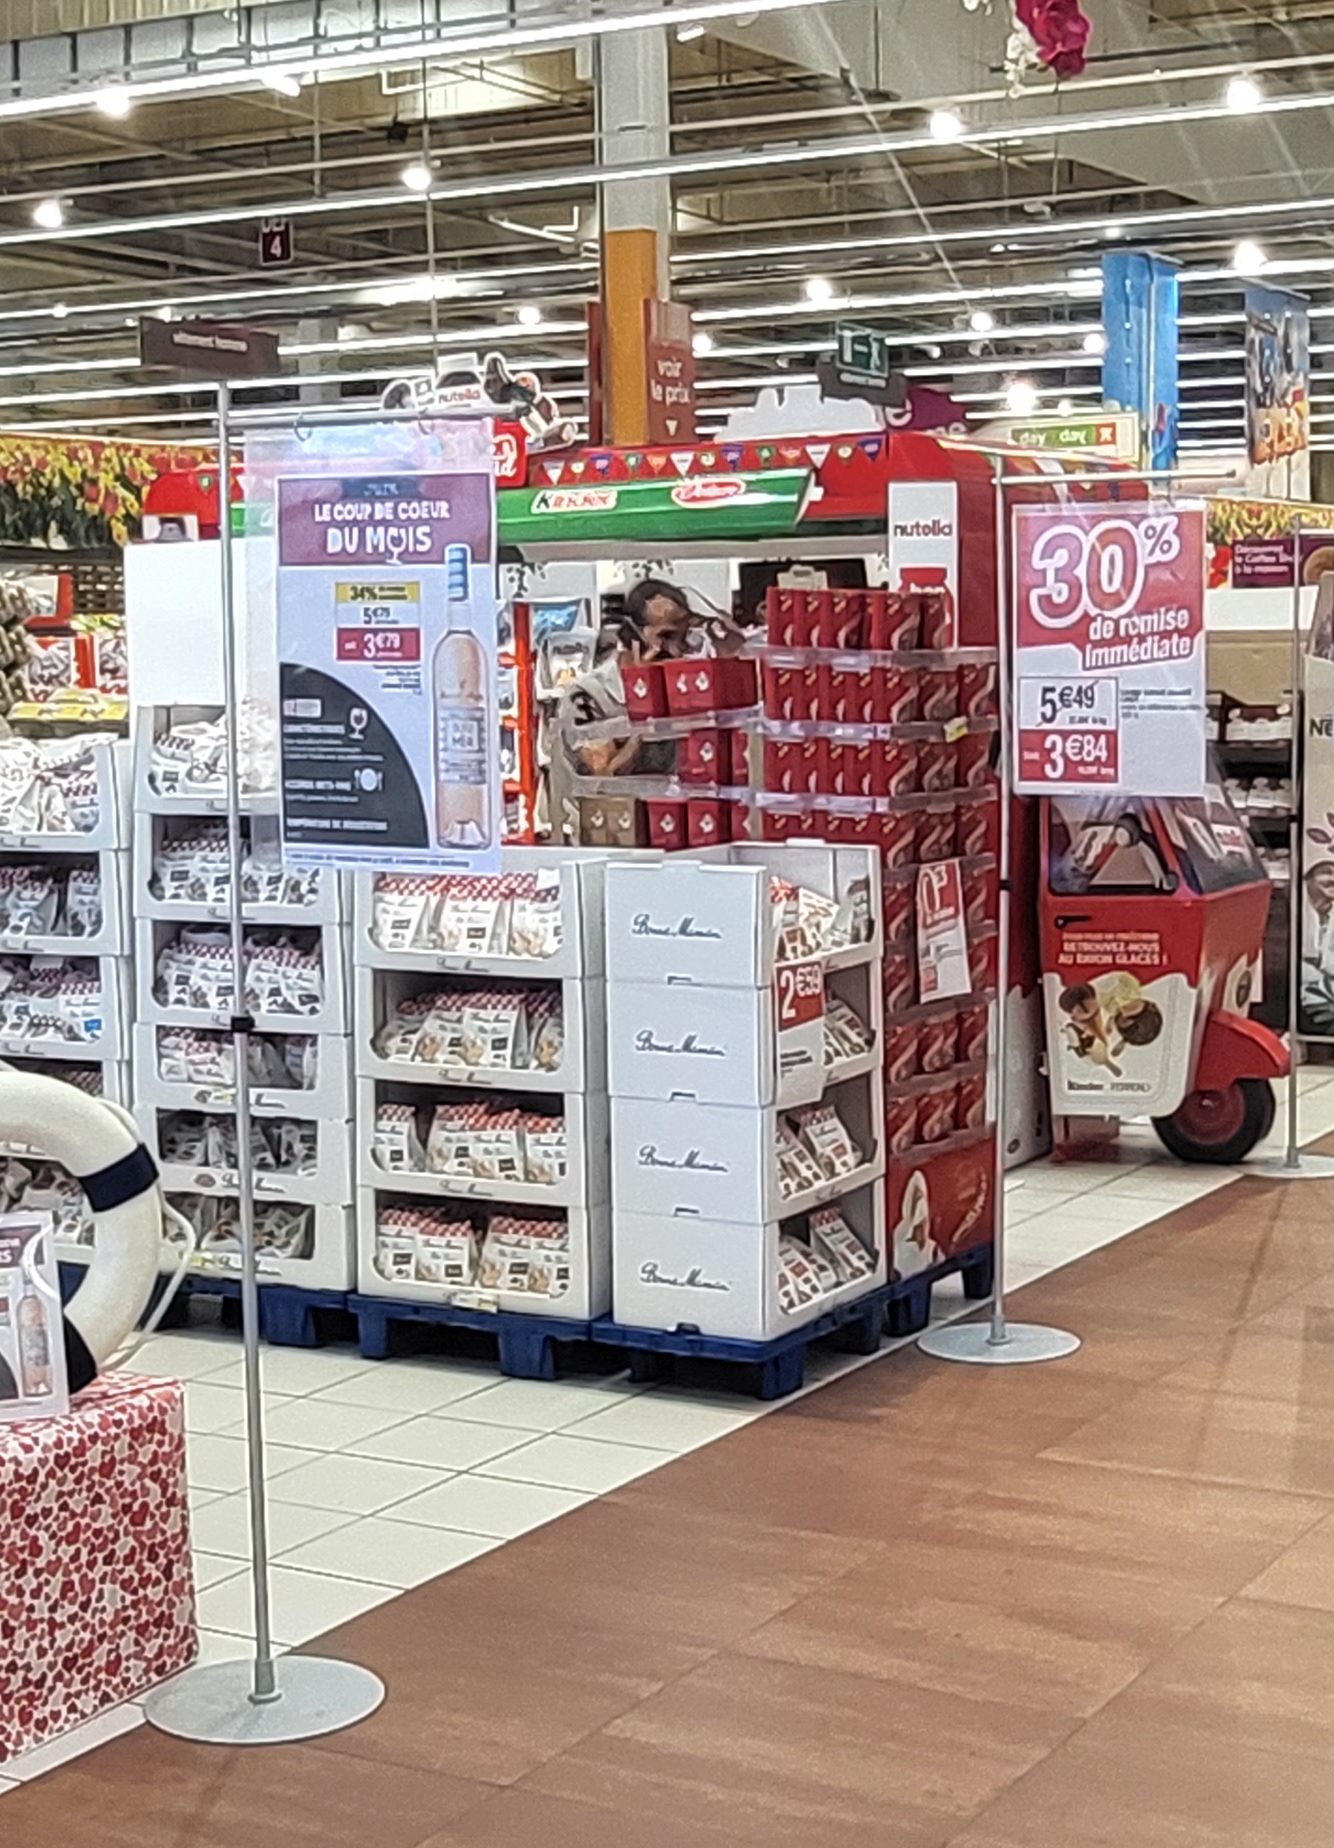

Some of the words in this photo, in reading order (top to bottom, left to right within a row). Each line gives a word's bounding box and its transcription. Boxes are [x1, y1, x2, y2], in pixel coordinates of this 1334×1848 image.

[657, 356, 683, 377] voir
[651, 379, 663, 401] le
[665, 381, 689, 406] prix
[314, 503, 331, 522] LE
[333, 503, 371, 522] COUP
[374, 501, 395, 520] DE
[398, 500, 451, 520] COEUR
[326, 526, 359, 554] DU
[893, 519, 953, 538] nutella
[1029, 515, 1180, 628] 30%
[1089, 616, 1114, 640] de
[1119, 604, 1190, 637] remise
[1085, 635, 1192, 668] immédiate
[1039, 685, 1096, 724] 5€49
[1043, 733, 1108, 779] 3€84
